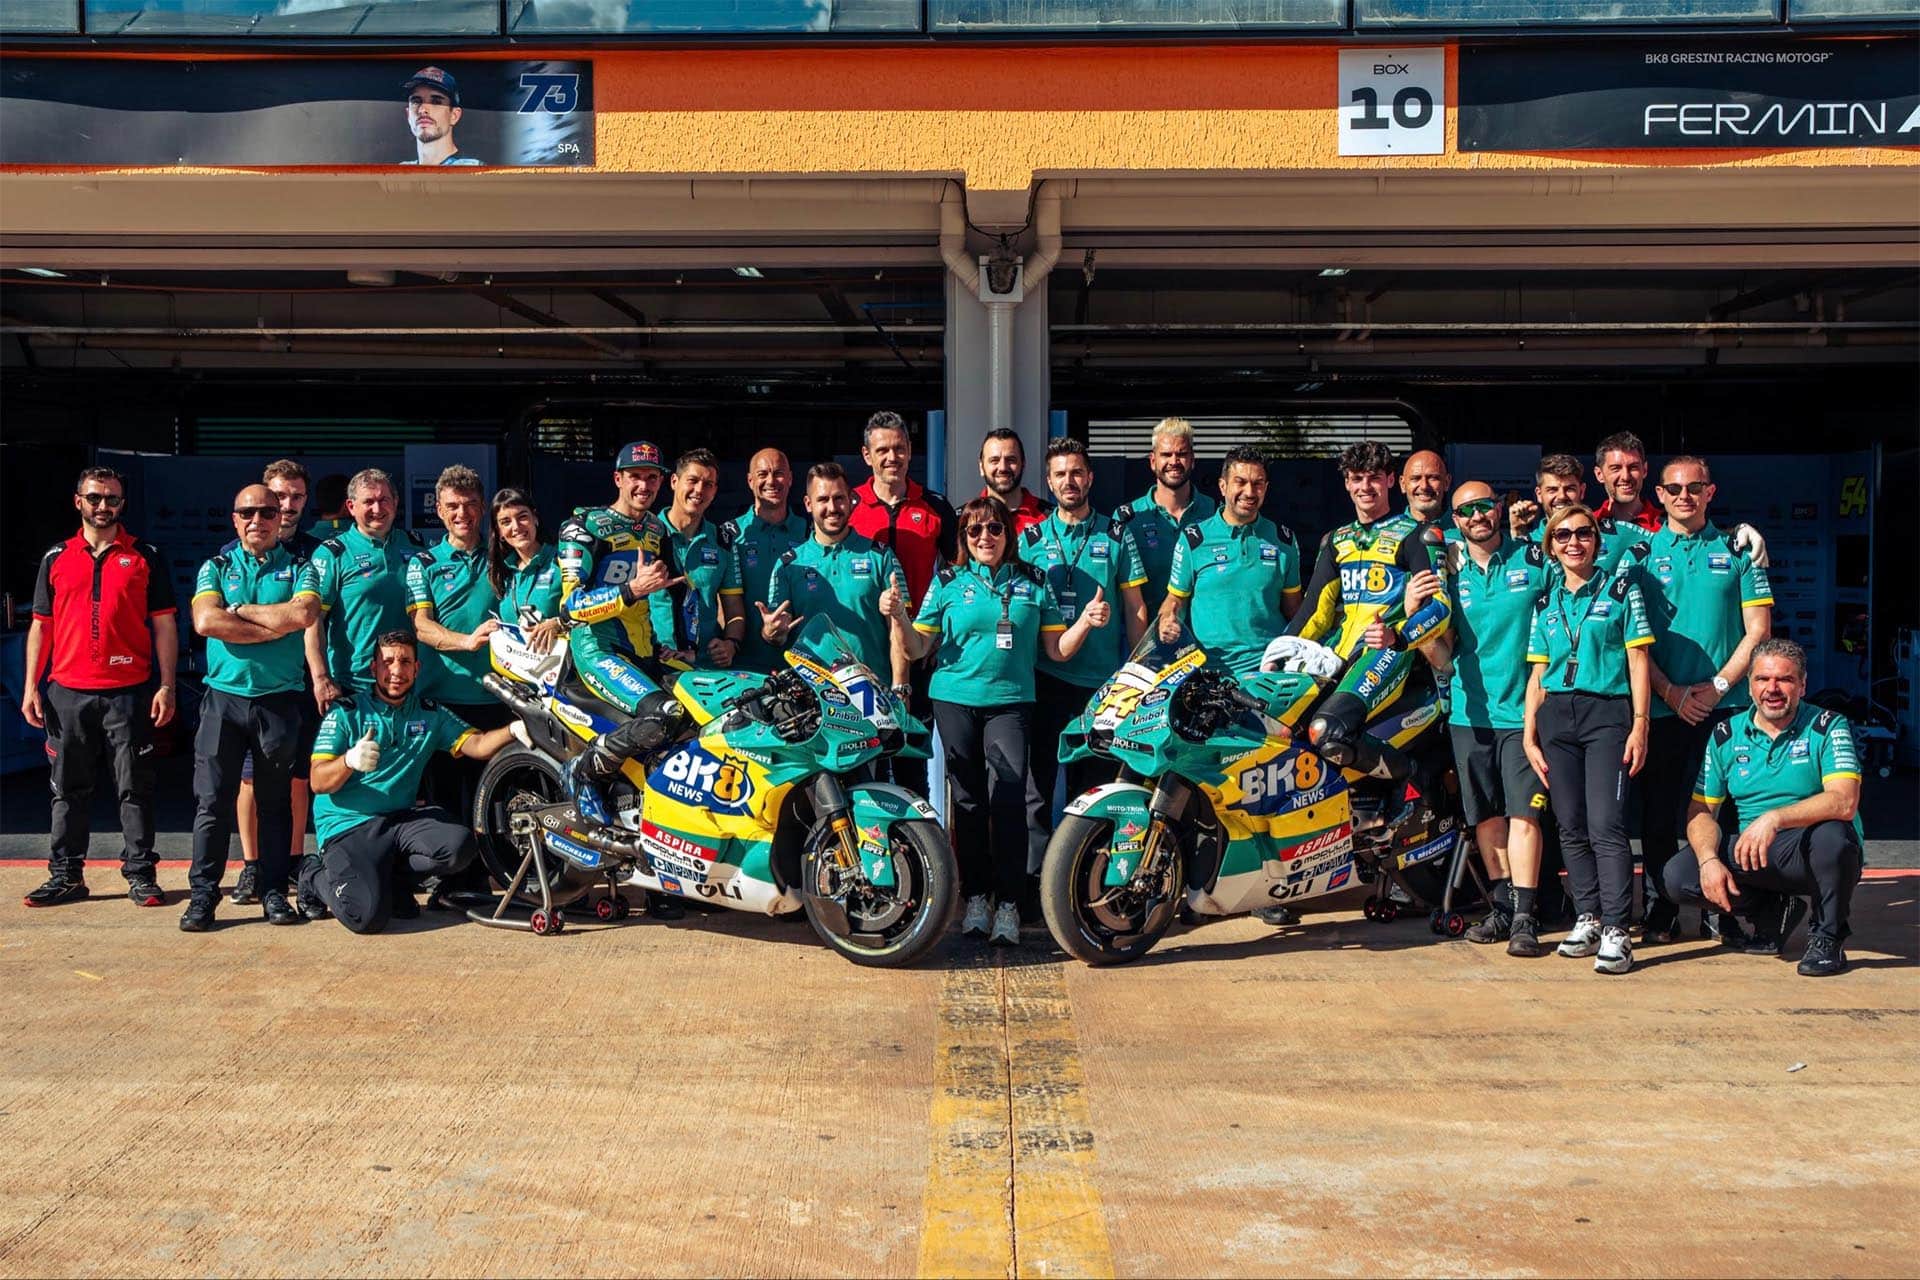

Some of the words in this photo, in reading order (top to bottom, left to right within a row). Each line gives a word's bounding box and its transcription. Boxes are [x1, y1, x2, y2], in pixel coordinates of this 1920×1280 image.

[1373, 64, 1409, 75] BOX
[1645, 53, 1669, 64] BK8
[1670, 53, 1724, 63] GRESINI
[1726, 53, 1774, 63] RACING
[517, 73, 580, 115] 73
[1350, 86, 1434, 130] 10
[1644, 103, 1886, 135] FERMIN
[557, 143, 580, 154] SPA
[1840, 476, 1868, 516] 54
[1341, 565, 1387, 592] BK8
[619, 673, 648, 695] NEWS
[1358, 669, 1381, 697] BK8
[1374, 647, 1397, 675] NEWS
[734, 747, 773, 765] DUCATI
[662, 749, 749, 804] BK8
[1241, 750, 1321, 804] BK8
[667, 780, 704, 803] NEWS
[1292, 789, 1326, 809] NEWS
[554, 840, 594, 861] MICHELIN
[655, 830, 703, 857] ASPIRA
[1294, 828, 1341, 857] ASPIRA
[1303, 839, 1351, 864] MODULA
[1417, 837, 1453, 859] MICHELIN
[695, 881, 743, 901] OLI
[1268, 879, 1314, 900] OLI
